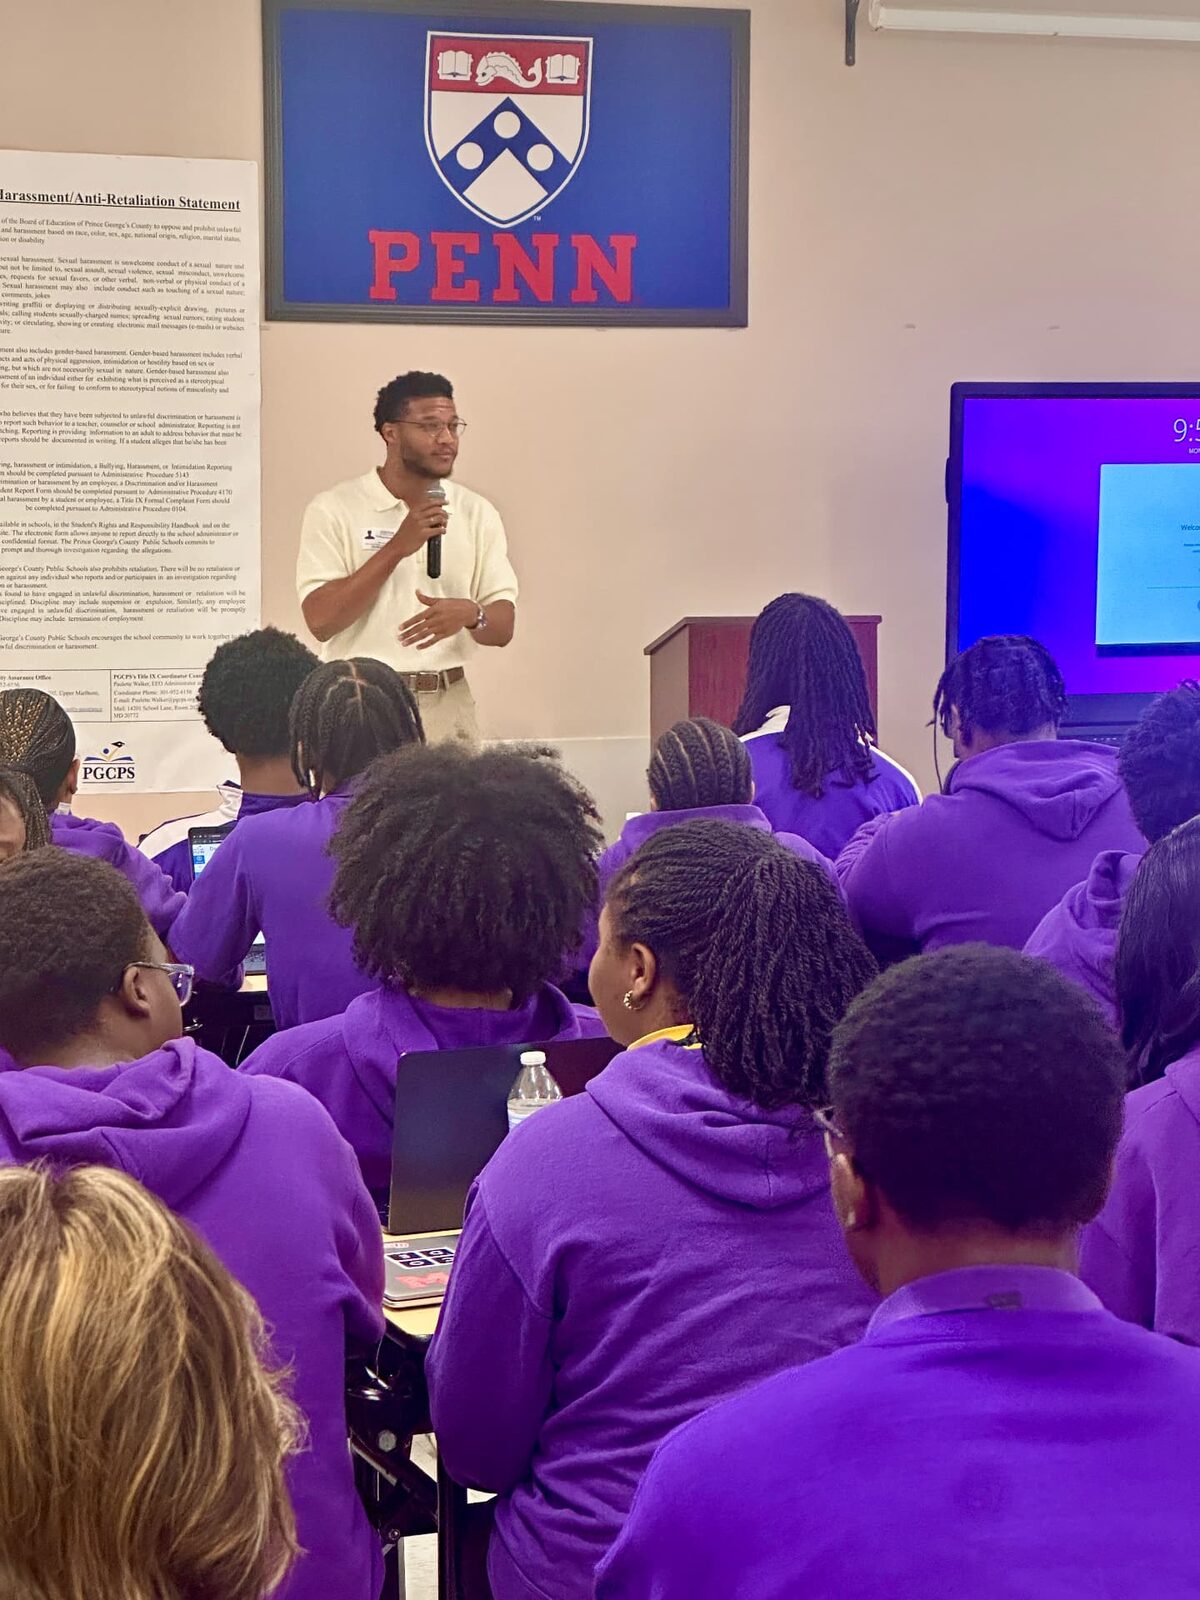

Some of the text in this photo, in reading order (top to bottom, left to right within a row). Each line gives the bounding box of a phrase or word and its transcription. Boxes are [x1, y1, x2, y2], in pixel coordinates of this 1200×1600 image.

[0, 189, 240, 209] arassment/Anti-Retaliation Statement
[368, 228, 638, 303] PENN
[83, 766, 135, 780] PGCPS
